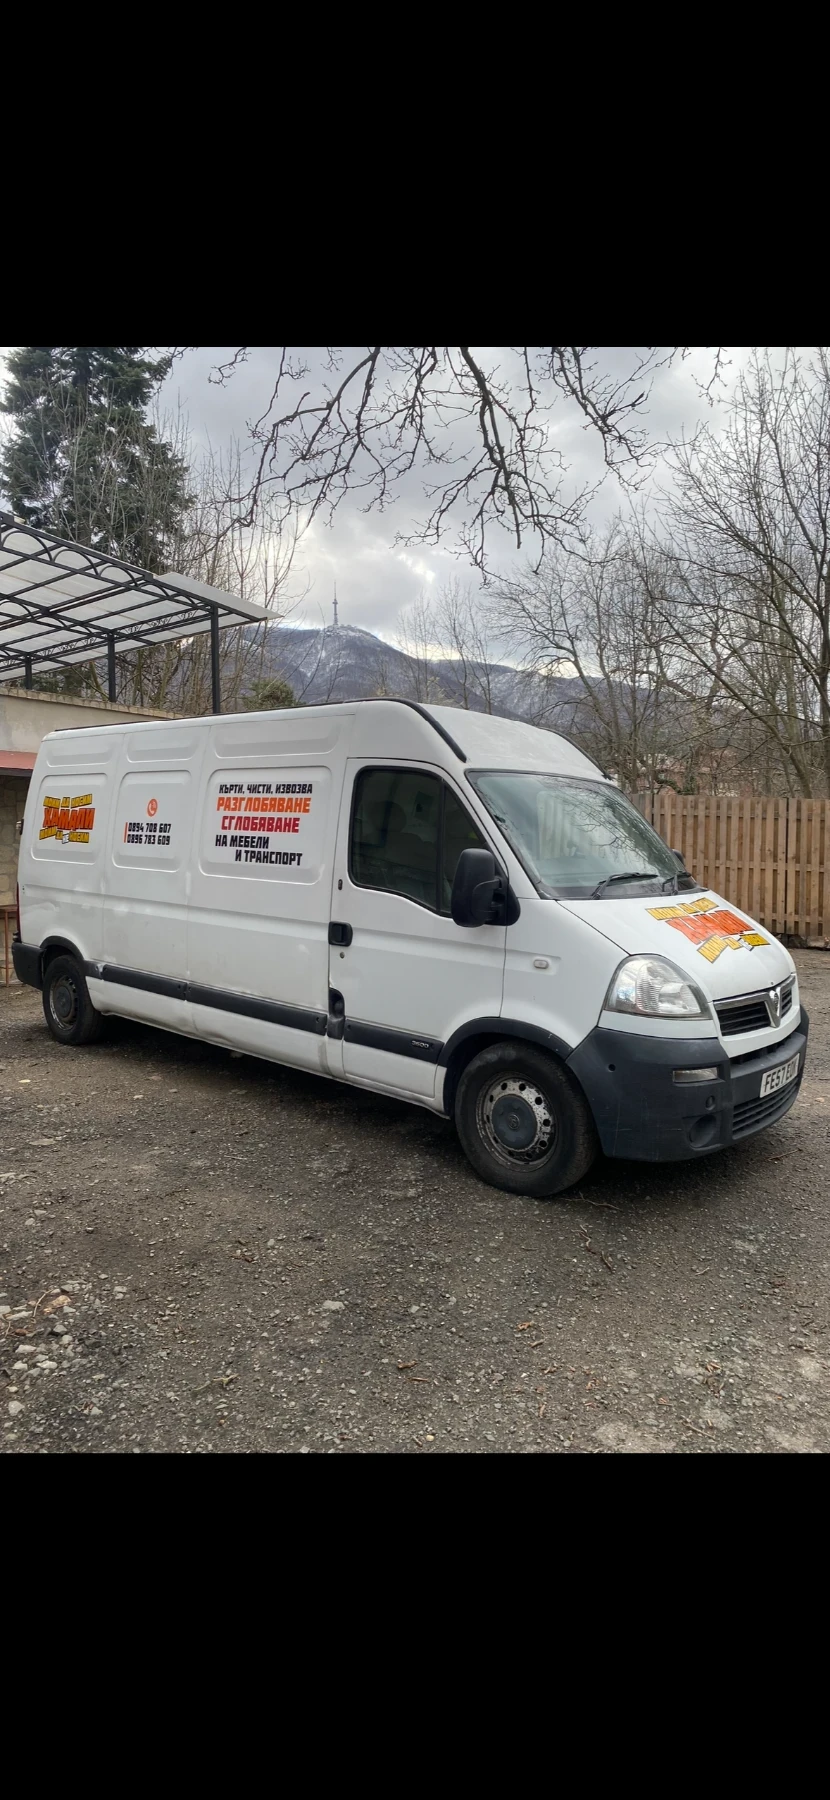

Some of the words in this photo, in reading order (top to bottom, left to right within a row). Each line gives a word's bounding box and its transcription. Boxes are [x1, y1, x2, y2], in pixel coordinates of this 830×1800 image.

[219, 784, 245, 795] КЪРТИ,
[247, 784, 273, 795] ЧИСТИ,
[275, 783, 313, 794] ИЗВОЗВА
[216, 797, 312, 813] РАЗГЛОБЯВАНЕ
[43, 808, 95, 831] ХАМАЛИ
[221, 815, 300, 833] СГЛОБЯВАНЕ
[128, 822, 144, 832] 0894
[146, 822, 157, 833] 708
[159, 823, 172, 834] 607
[127, 833, 143, 844] 0896
[144, 834, 156, 845] 783
[157, 835, 171, 846] 609
[215, 834, 228, 847] НА
[229, 835, 270, 849] МЕБЕЛИ
[235, 849, 242, 862] И
[244, 849, 303, 866] ТРАНСПОРТ
